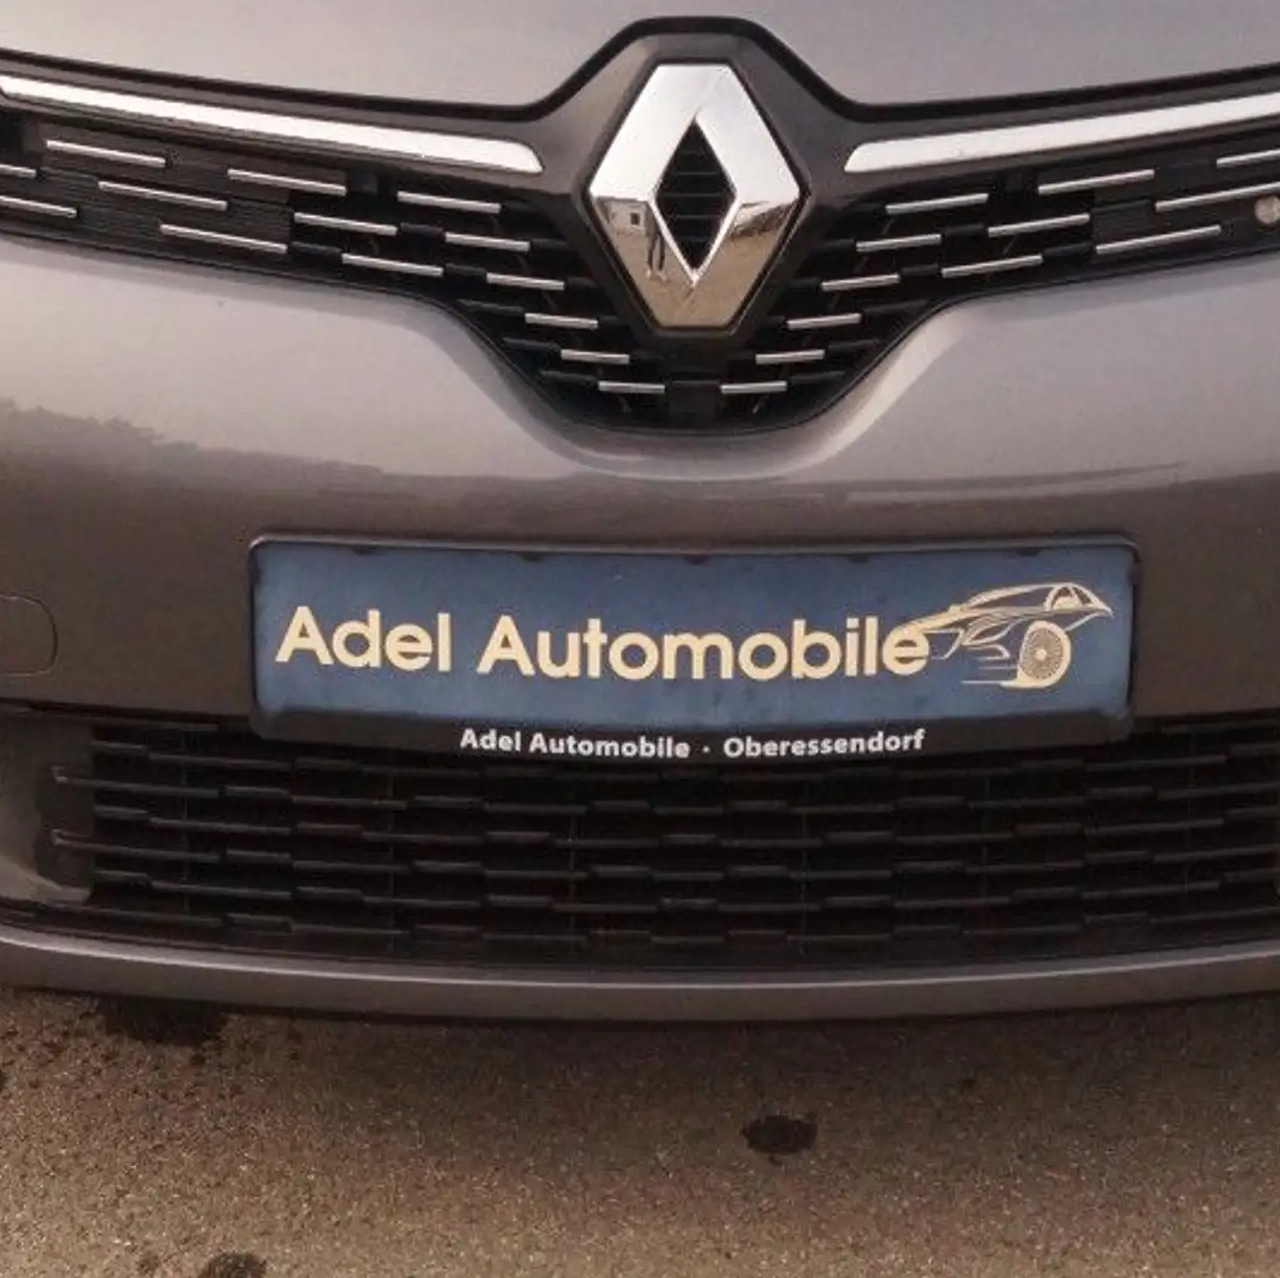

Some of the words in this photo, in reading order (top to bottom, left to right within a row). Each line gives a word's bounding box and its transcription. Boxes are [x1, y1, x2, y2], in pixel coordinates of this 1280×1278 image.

[275, 605, 452, 672] Adel
[476, 614, 931, 680] Automobile
[459, 727, 522, 752] Adel
[528, 732, 690, 759] Automobile
[723, 728, 926, 759] Oberessendorf
